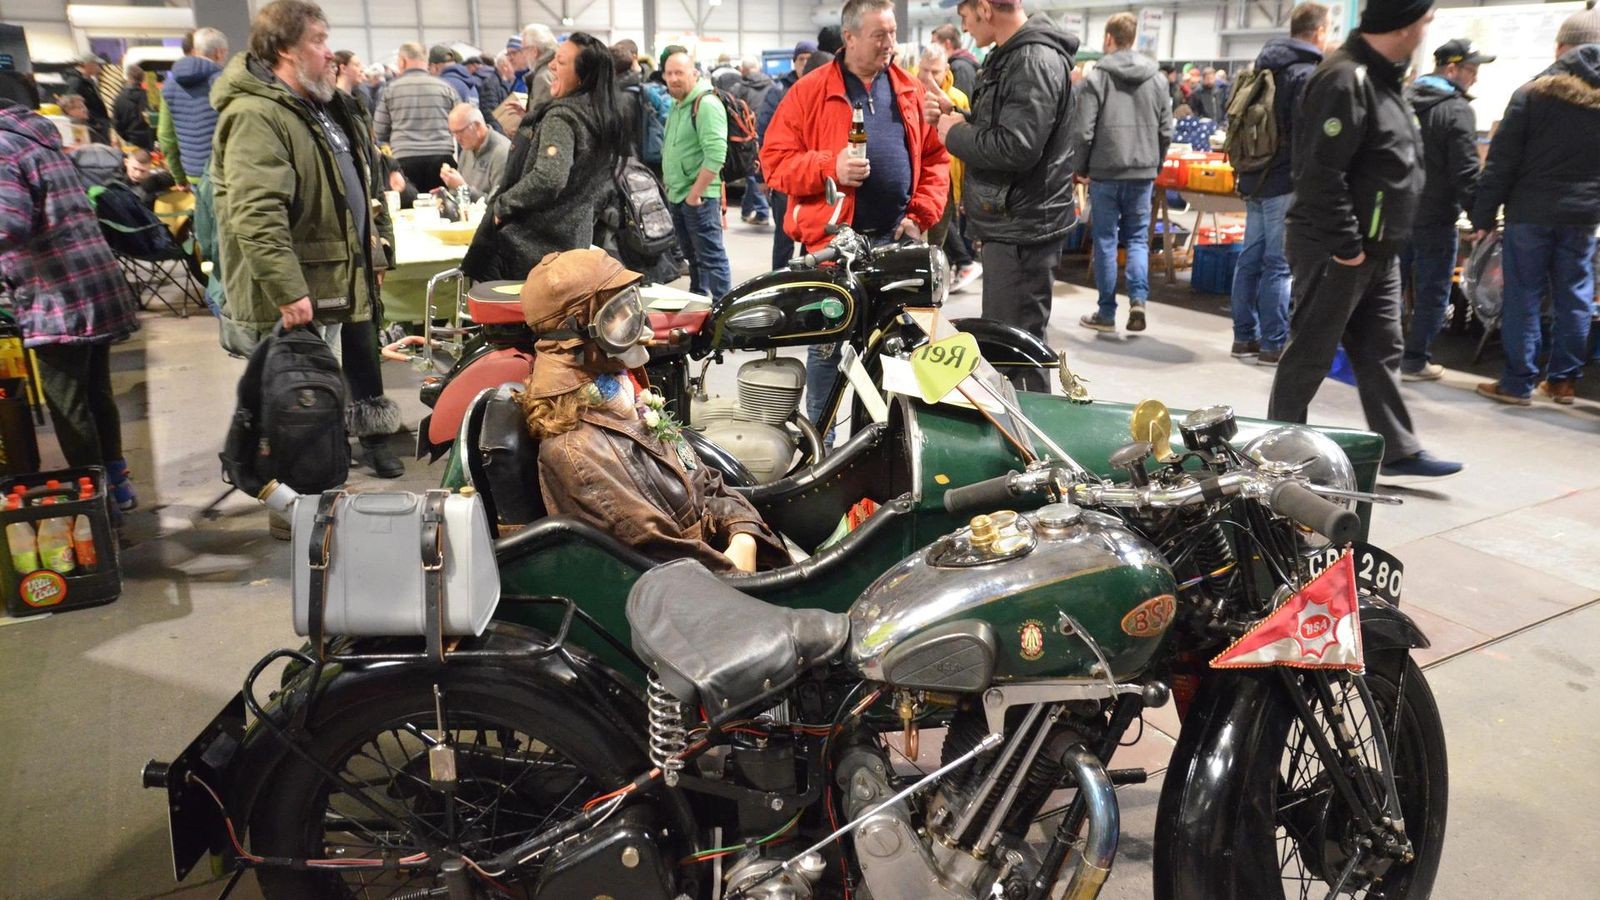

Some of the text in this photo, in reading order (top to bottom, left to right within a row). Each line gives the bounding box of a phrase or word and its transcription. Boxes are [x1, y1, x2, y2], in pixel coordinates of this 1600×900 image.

[1358, 552, 1402, 598] 280
[32, 585, 60, 602] Cola
[1135, 600, 1175, 632] BSA
[1302, 618, 1328, 635] BSA
